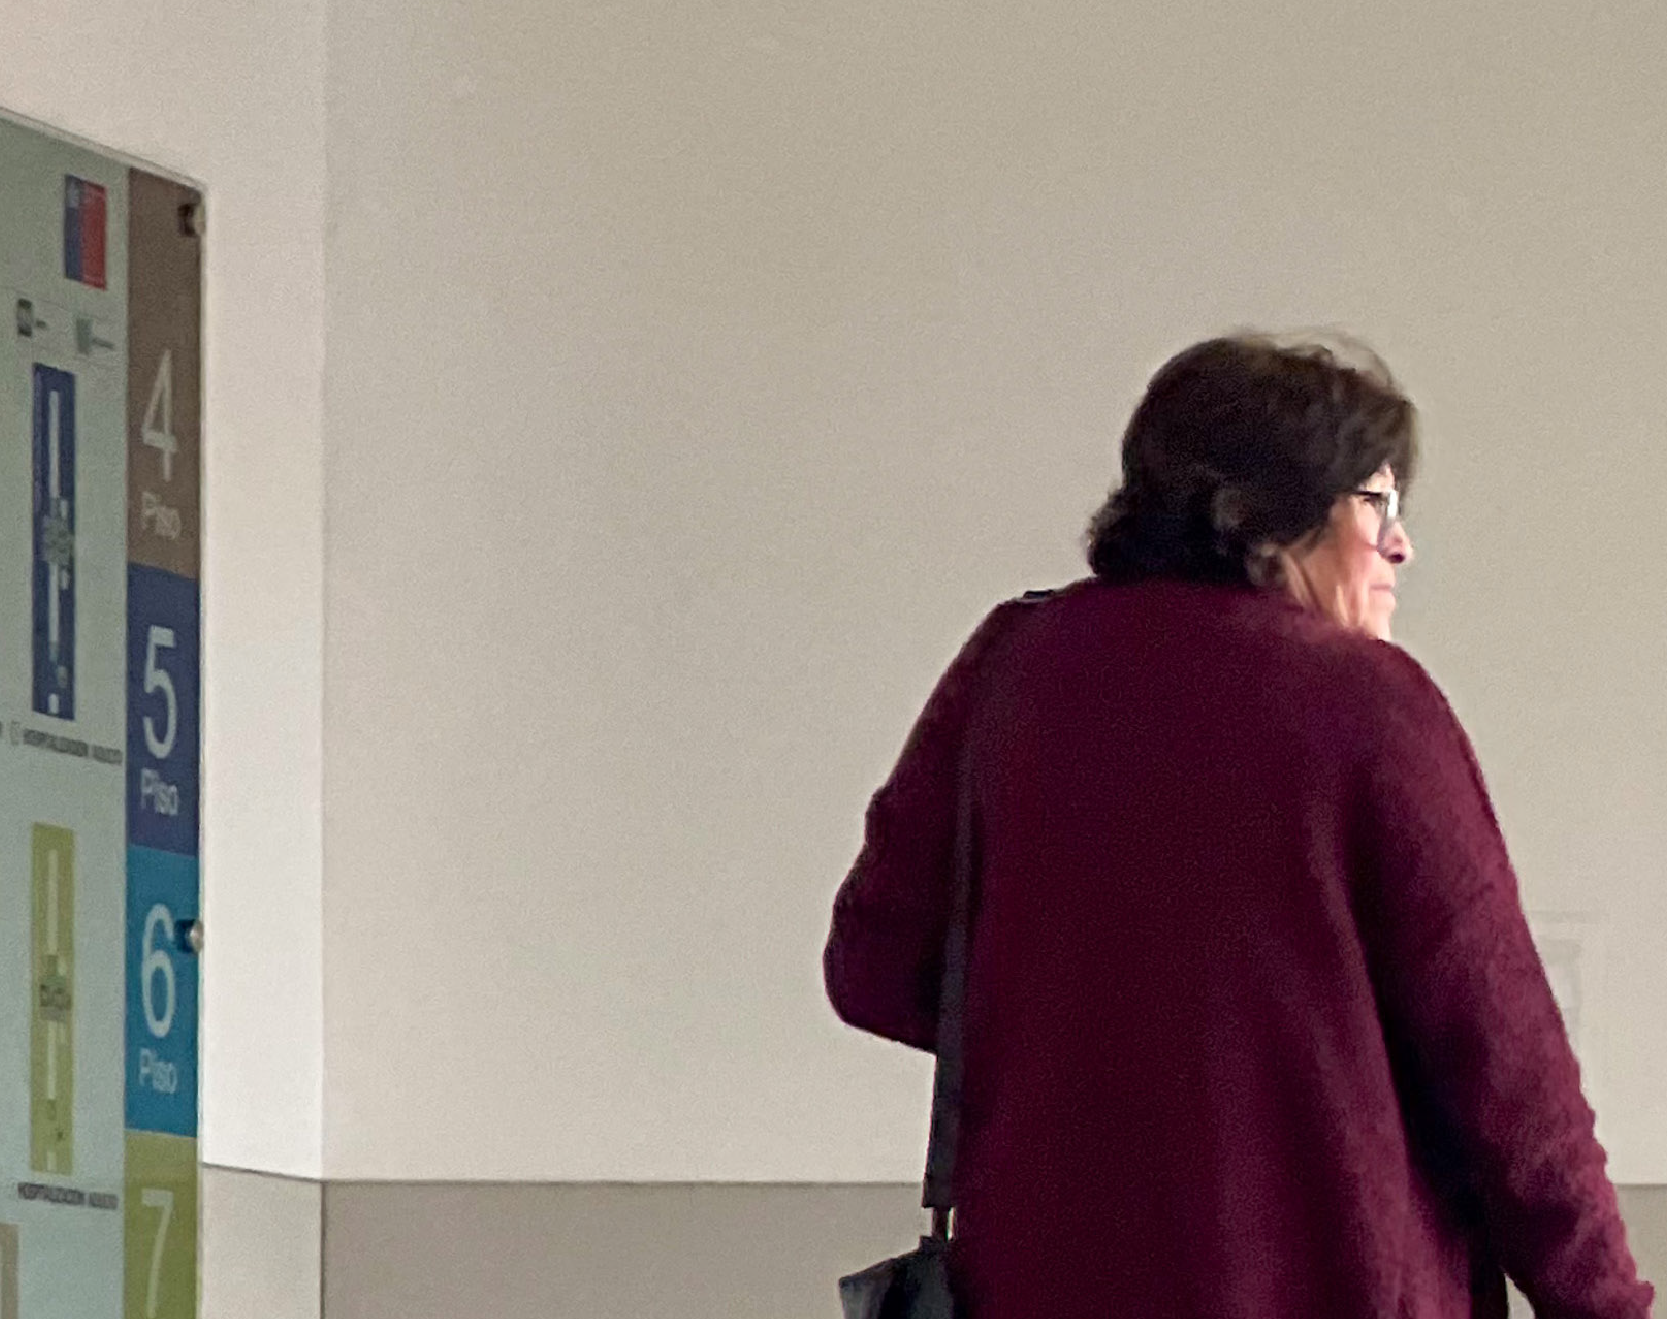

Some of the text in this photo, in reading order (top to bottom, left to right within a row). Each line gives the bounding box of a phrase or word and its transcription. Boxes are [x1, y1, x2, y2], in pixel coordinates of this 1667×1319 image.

[142, 350, 176, 481] 4
[143, 625, 177, 759] 5
[141, 768, 178, 816] Piso
[142, 903, 175, 1038] 6
[139, 1047, 177, 1094] Piso
[141, 1188, 174, 1319] 7
